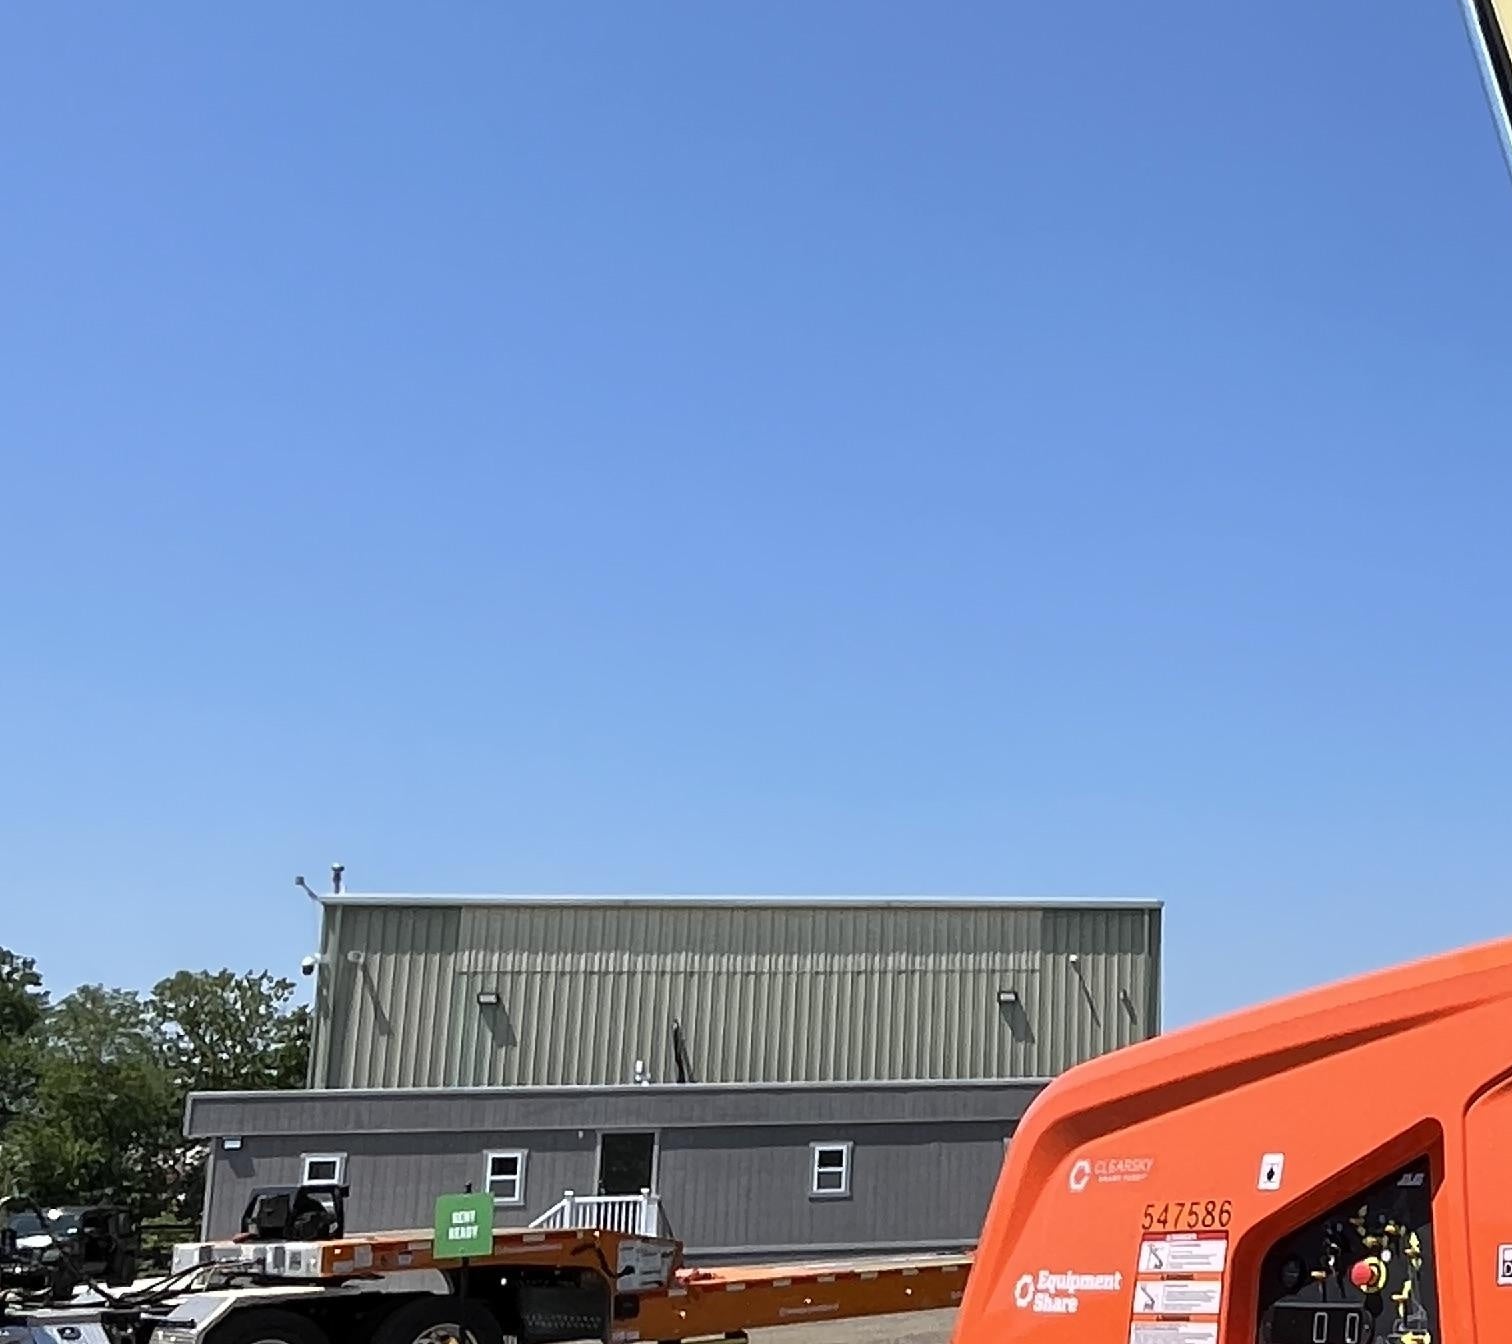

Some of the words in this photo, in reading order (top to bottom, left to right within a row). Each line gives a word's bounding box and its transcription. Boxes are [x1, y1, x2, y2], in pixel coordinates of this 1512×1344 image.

[1141, 1200, 1232, 1230] 547586
[1036, 1270, 1122, 1293] Equipment
[1033, 1292, 1078, 1313] Share
